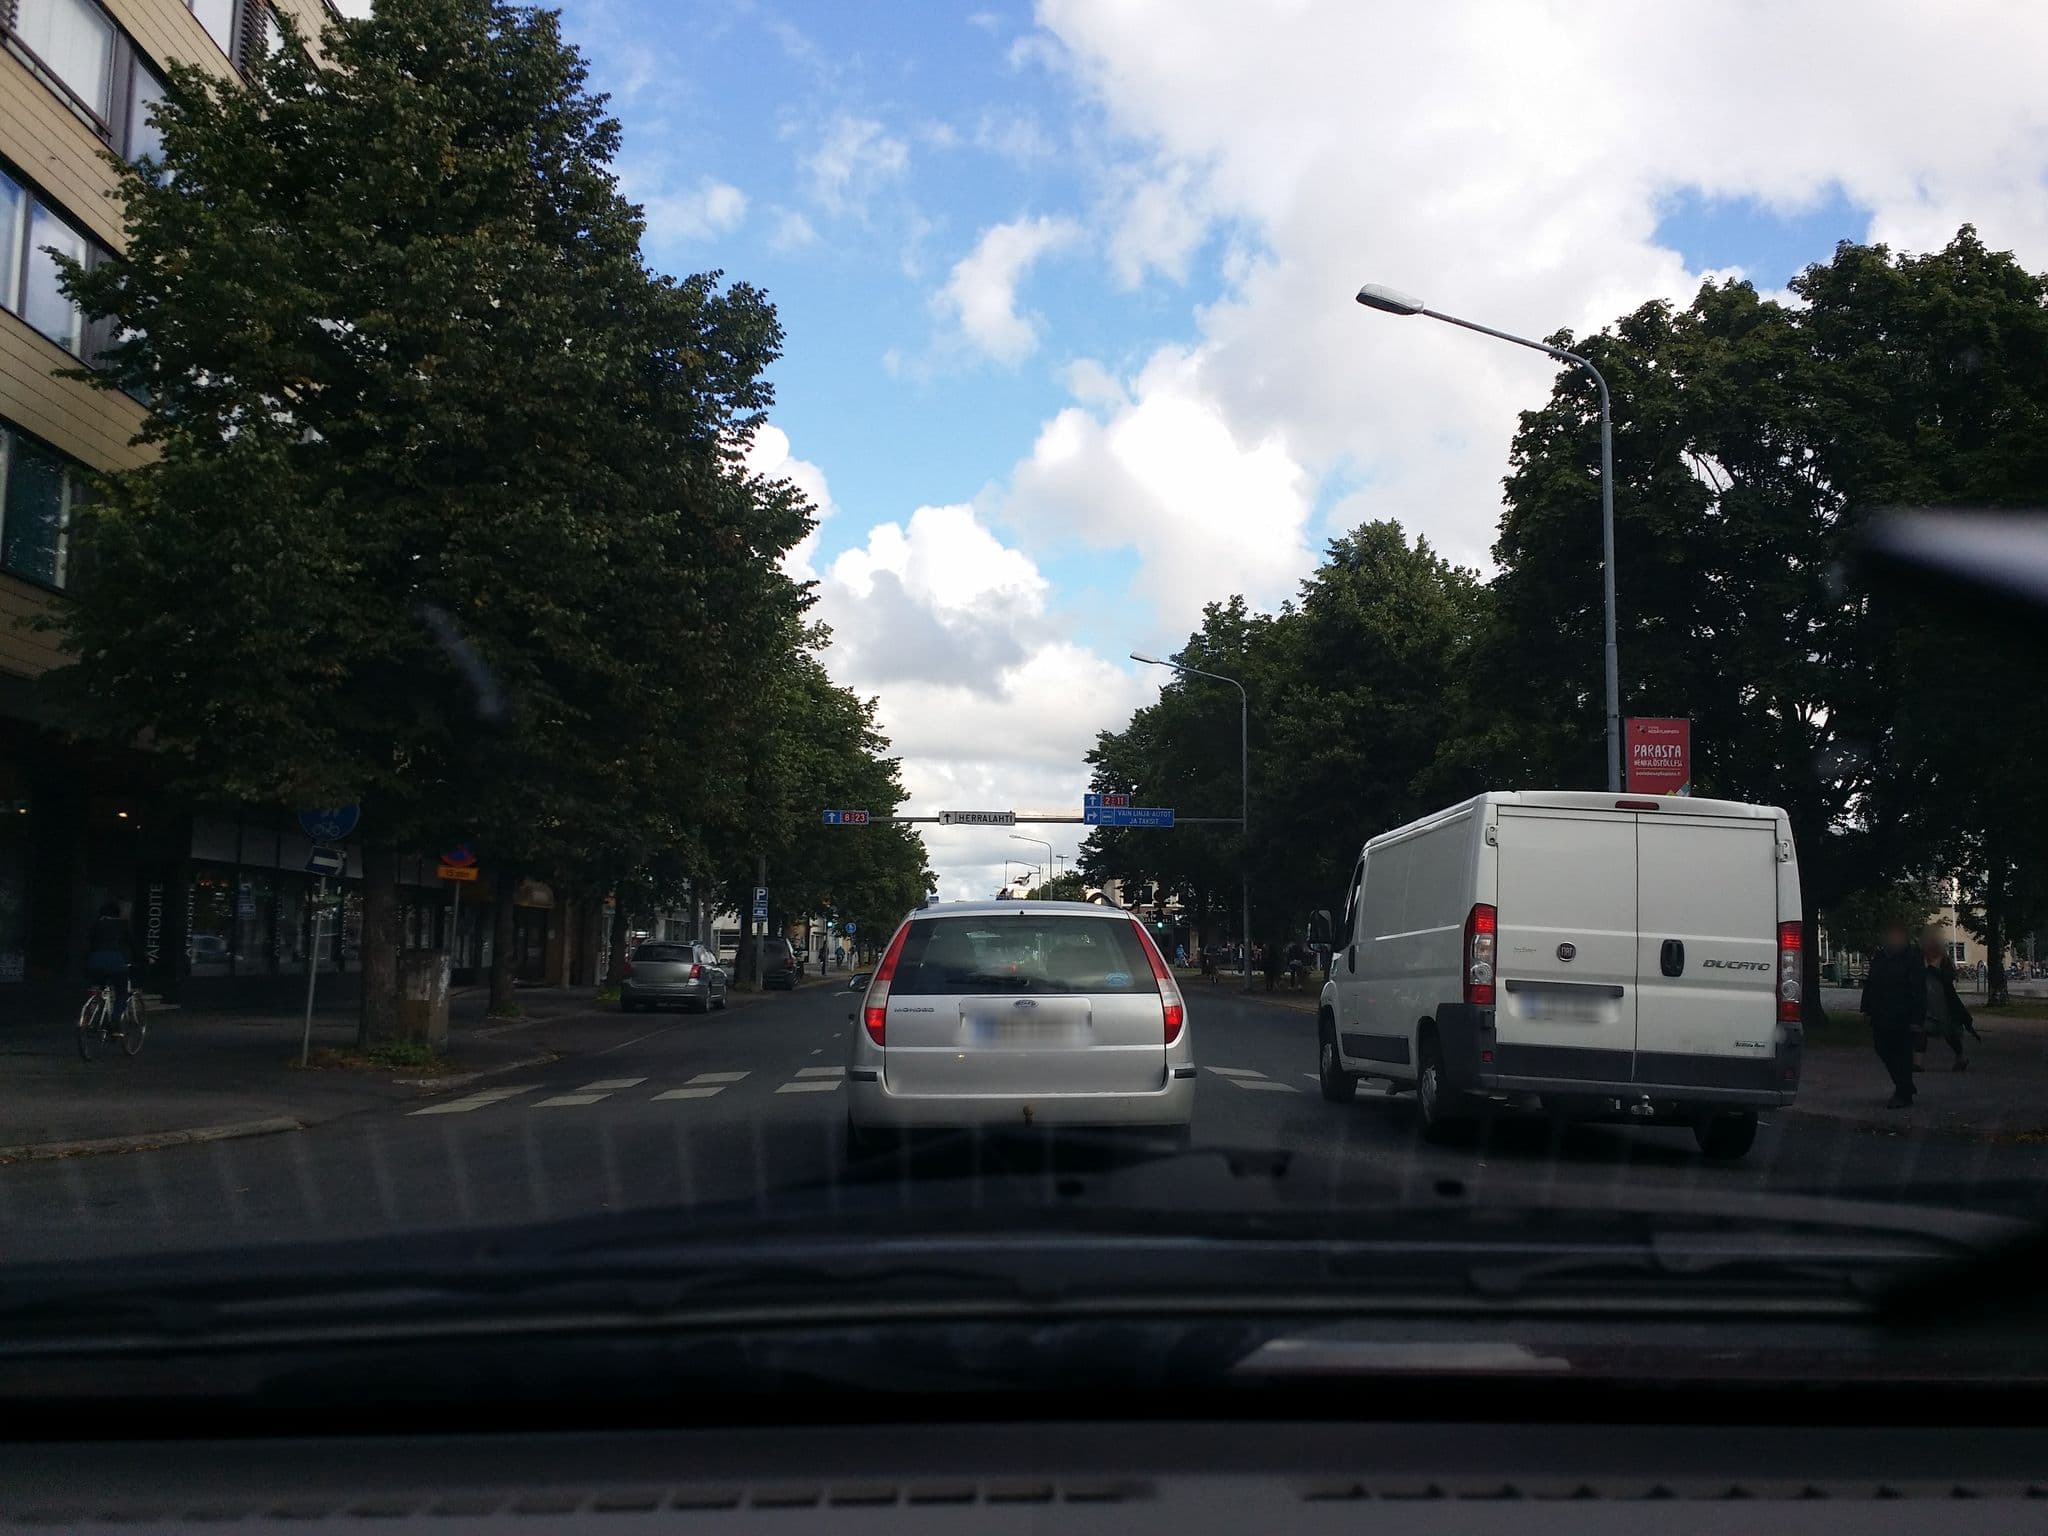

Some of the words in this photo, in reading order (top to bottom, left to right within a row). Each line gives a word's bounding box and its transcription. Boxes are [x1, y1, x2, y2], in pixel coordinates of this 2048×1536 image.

[1634, 744, 1681, 758] PARASTA
[855, 813, 865, 822] 23
[958, 813, 1013, 824] HERRALAHTI
[757, 888, 766, 900] P
[144, 879, 163, 961] AFRODITE
[1702, 959, 1771, 971] DUCATO
